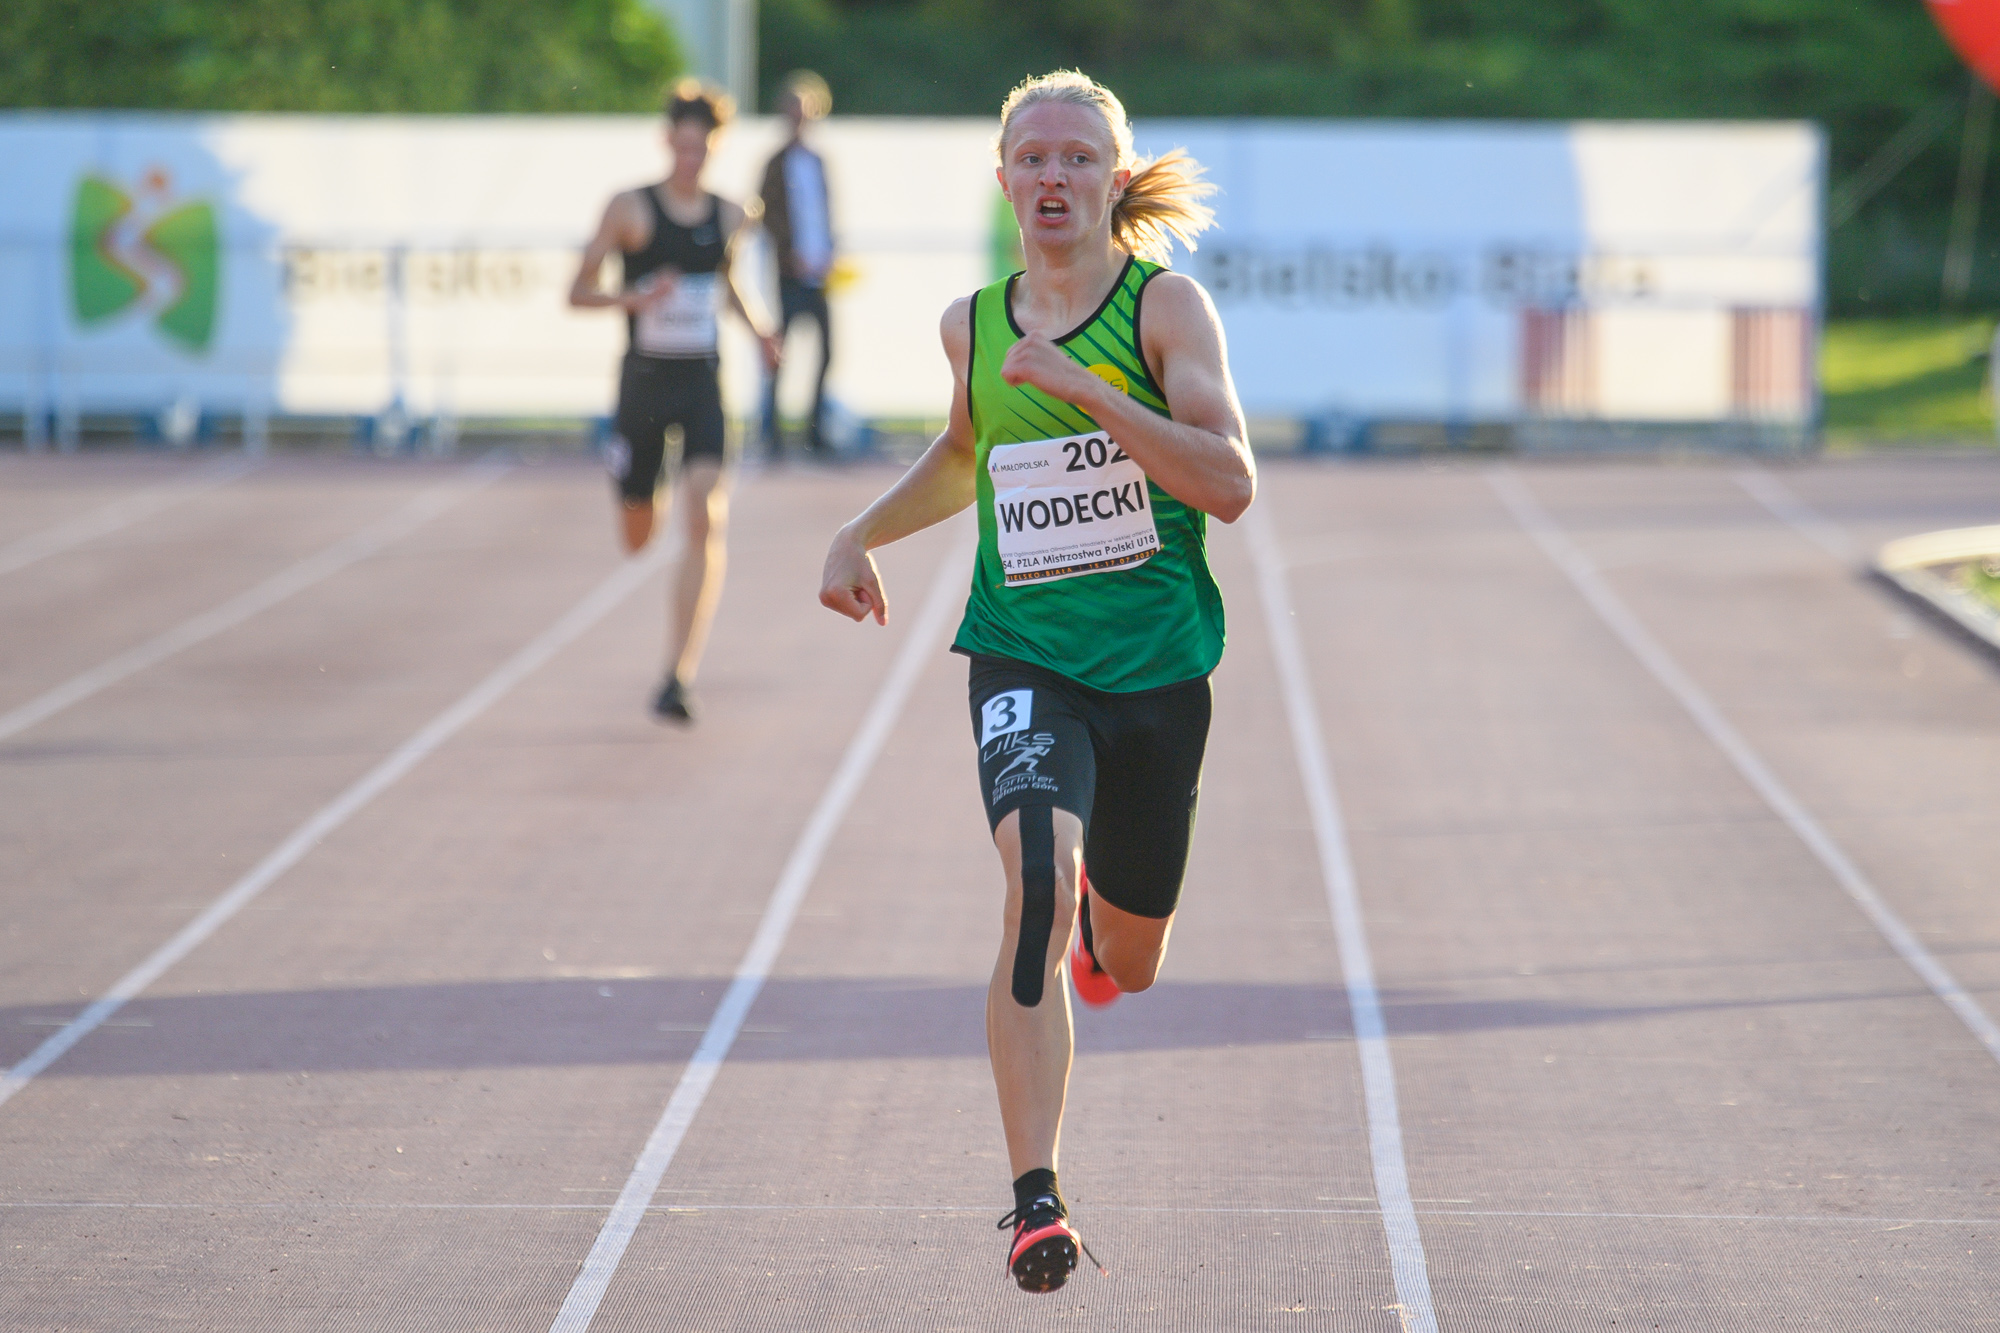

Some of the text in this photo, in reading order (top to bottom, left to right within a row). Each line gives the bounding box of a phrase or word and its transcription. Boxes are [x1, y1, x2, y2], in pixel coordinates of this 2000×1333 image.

[1000, 459, 1050, 473] MAŁOPOLSKA
[1000, 480, 1146, 534] WODECKI
[1017, 557, 1041, 569] PZLA
[1043, 549, 1102, 565] Mistrzostwa
[1104, 540, 1135, 556] Polski
[1136, 534, 1156, 548] U18
[989, 695, 1017, 734] 3
